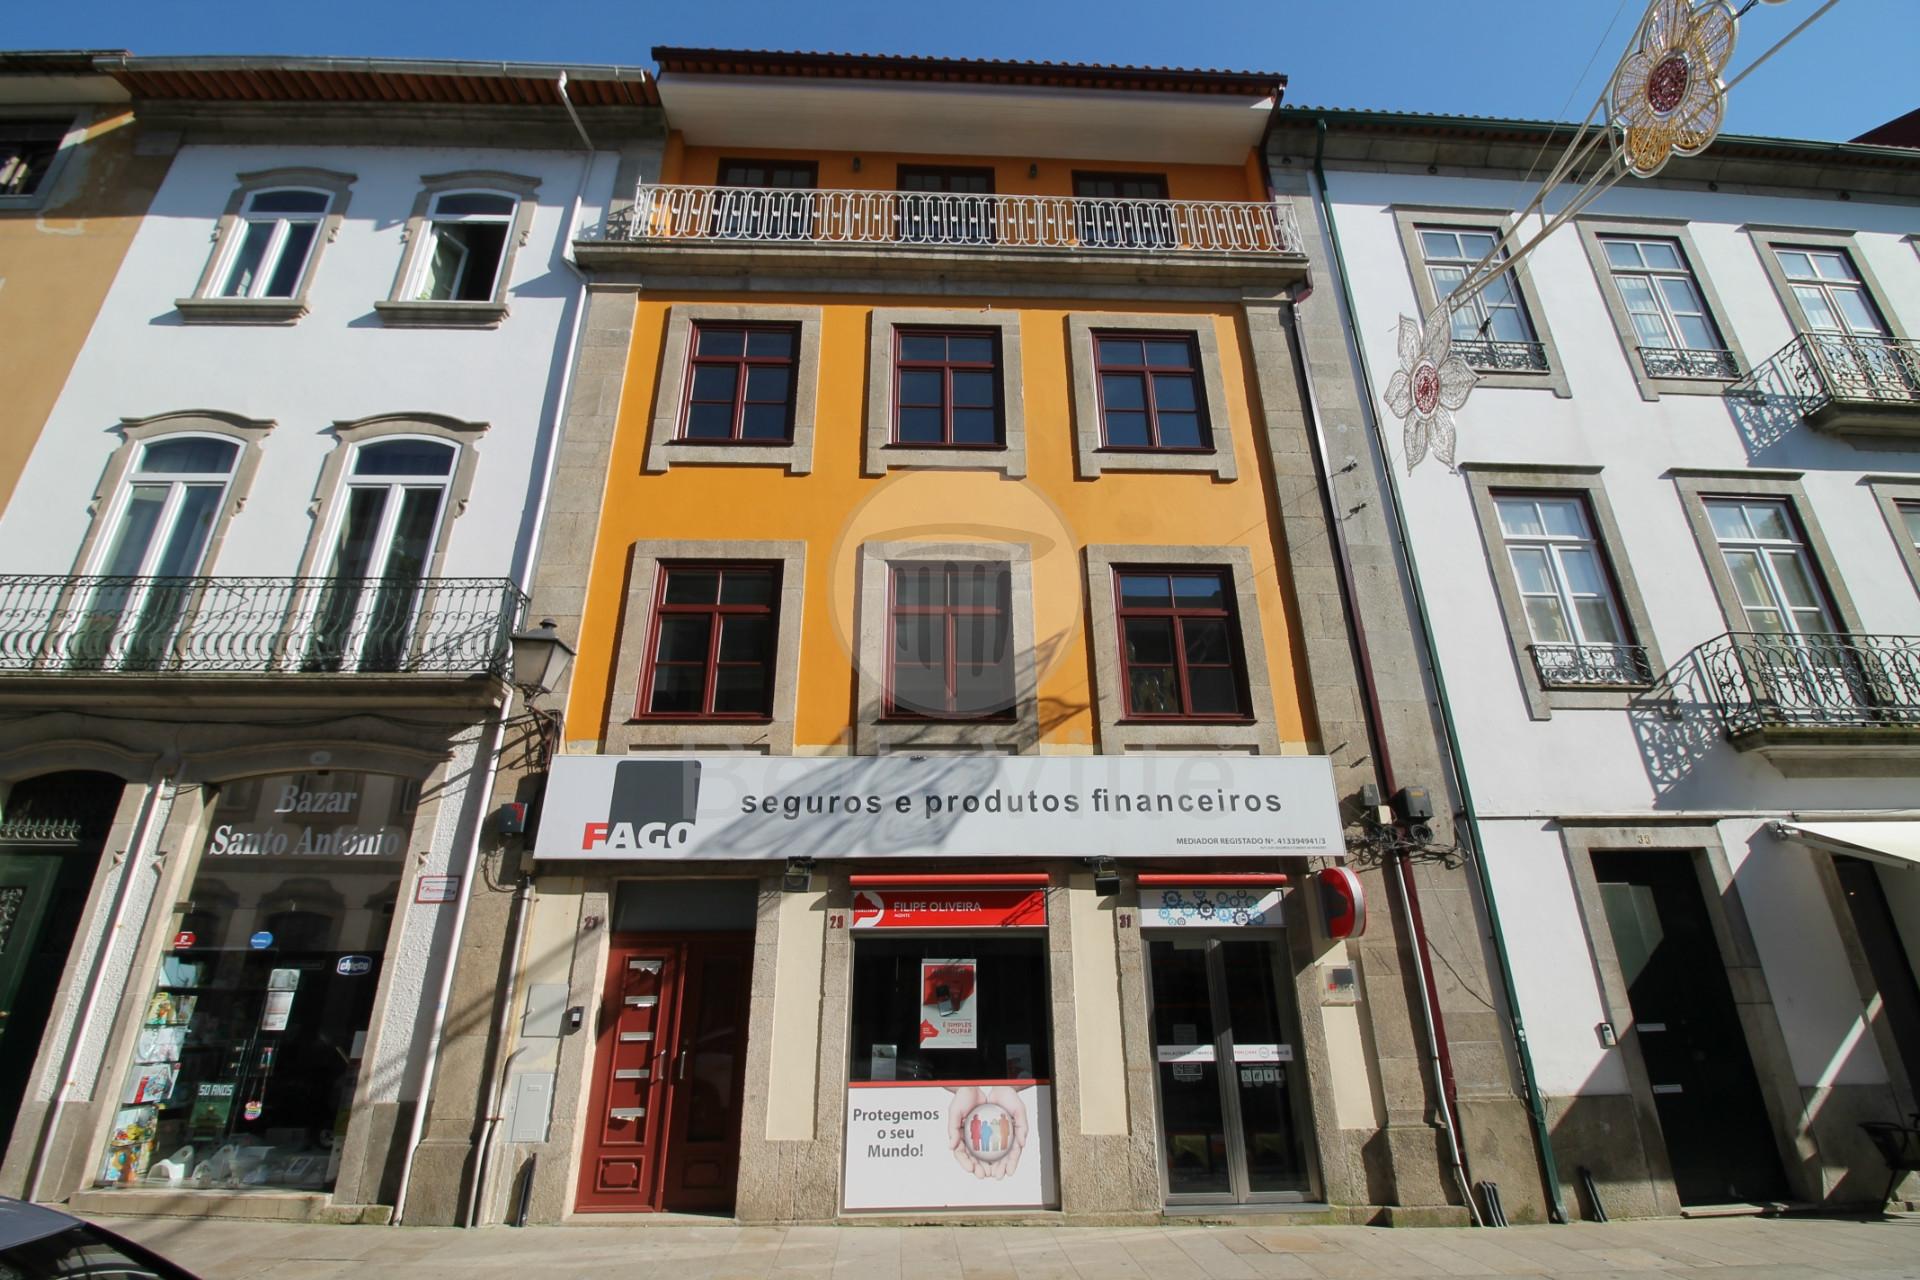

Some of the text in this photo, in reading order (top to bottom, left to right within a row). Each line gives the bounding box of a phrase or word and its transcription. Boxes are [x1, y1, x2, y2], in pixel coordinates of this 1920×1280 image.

[274, 784, 358, 813] Bazar
[741, 788, 1282, 820] seguros e produtos financeiros
[209, 825, 401, 856] Santo António
[582, 822, 696, 850] FAGO
[1176, 837, 1219, 845] MEDIADOR
[1220, 837, 1264, 845] REGISTADO
[893, 902, 982, 912] FILIPE OLIVEIRA
[829, 915, 844, 929] 29
[1119, 914, 1132, 928] 31
[198, 1084, 234, 1096] 50 ANOS
[852, 1108, 940, 1124] Protegemos
[877, 1129, 914, 1140] o seu
[867, 1145, 924, 1158] Mundo!
